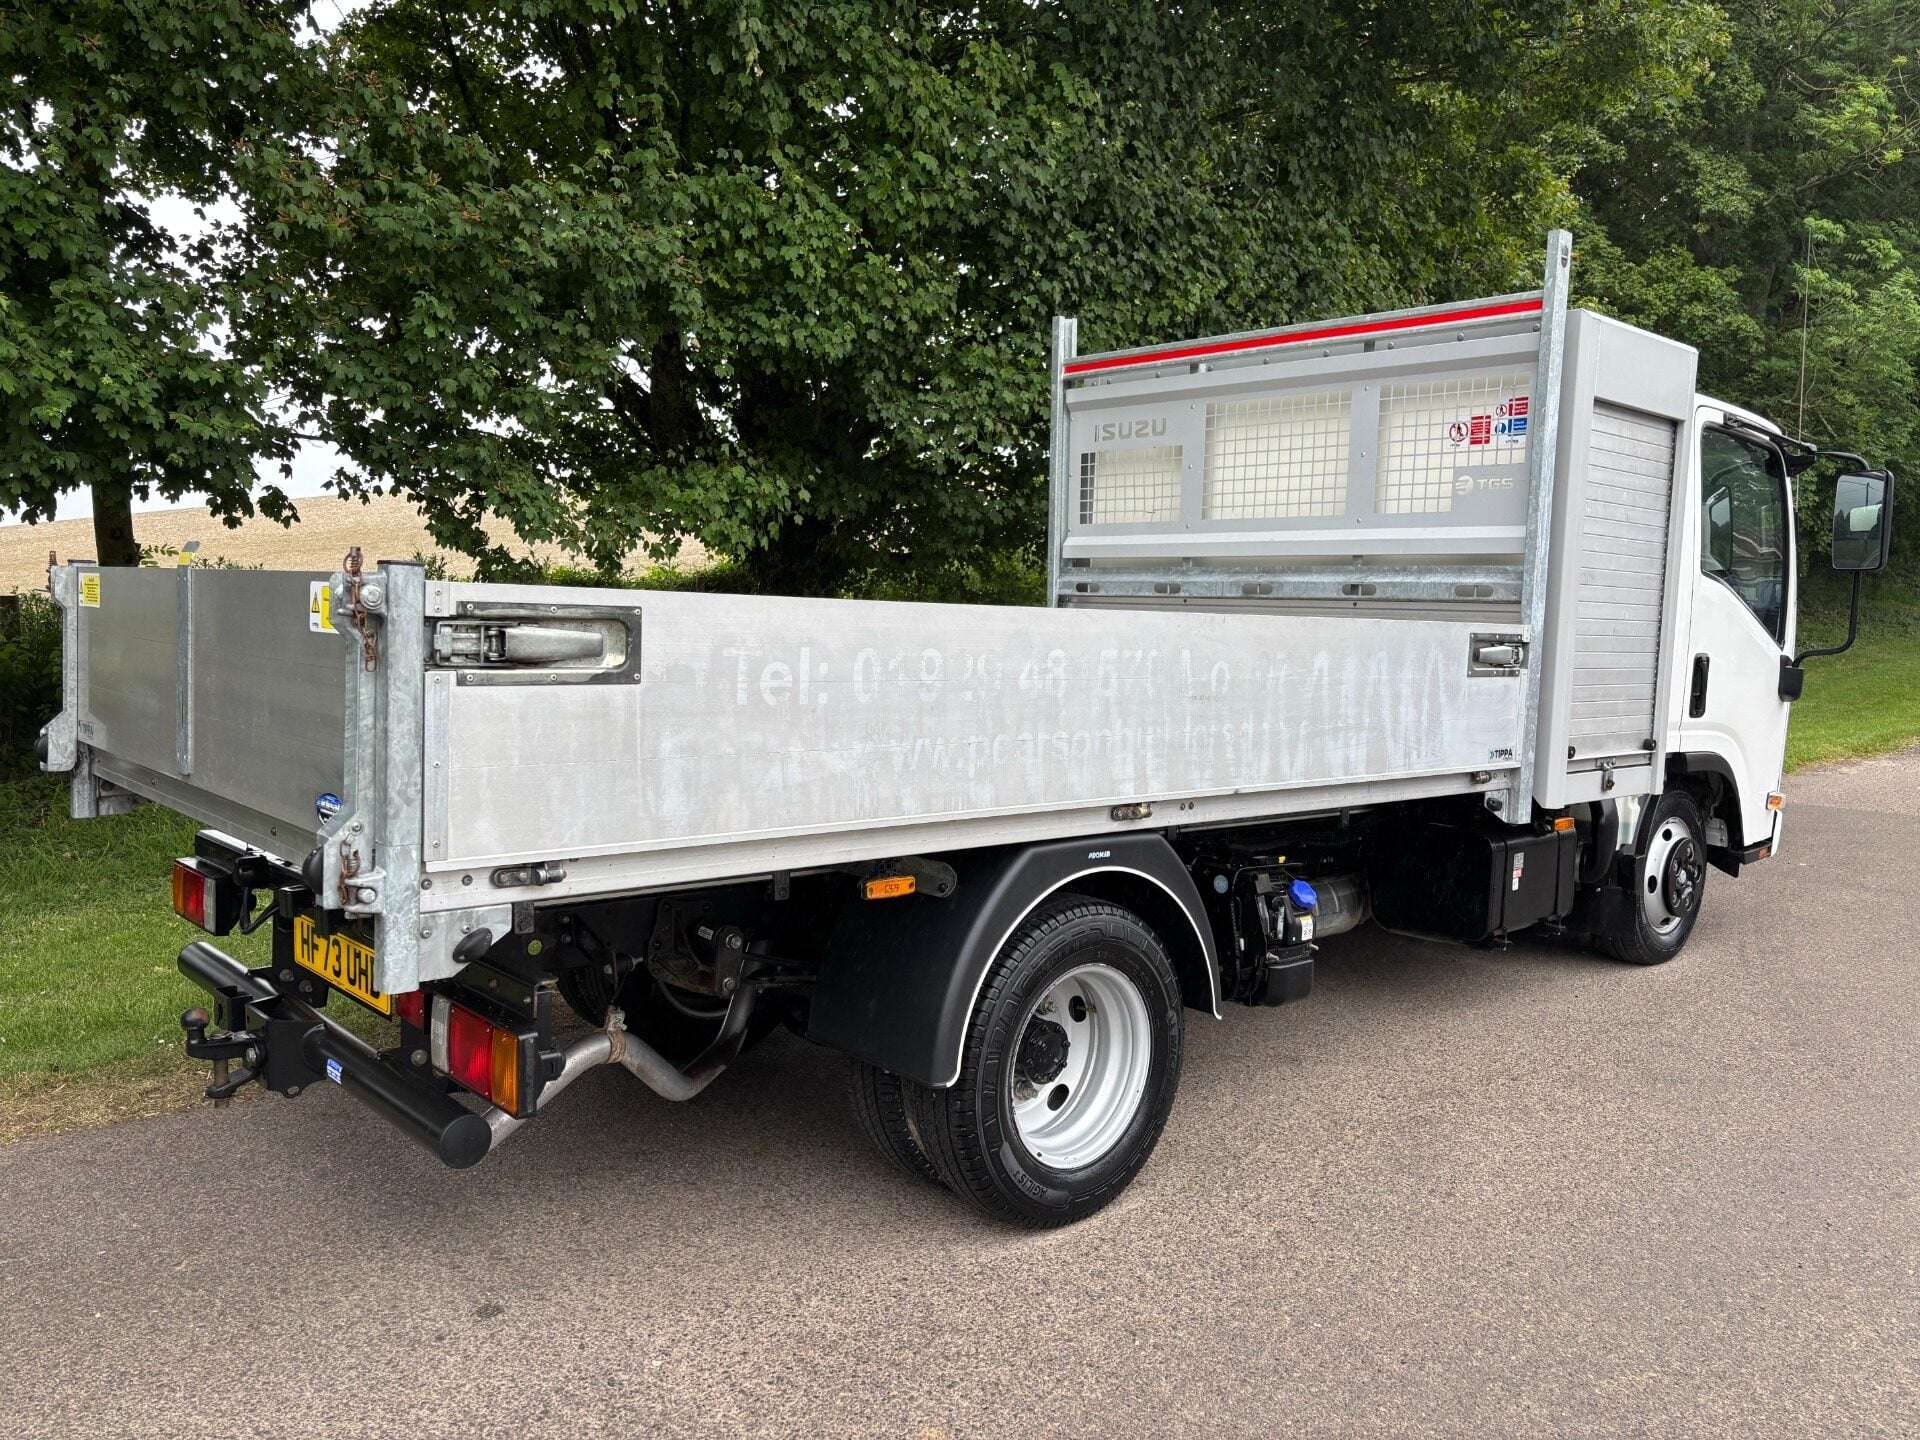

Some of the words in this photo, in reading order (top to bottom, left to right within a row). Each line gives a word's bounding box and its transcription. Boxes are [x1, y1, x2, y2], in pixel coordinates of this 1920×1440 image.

[1094, 417, 1167, 442] ISUZU
[1477, 478, 1514, 490] TGS
[722, 646, 829, 706] Tel:
[1495, 747, 1513, 759] TIPPA
[301, 920, 342, 978] HF73
